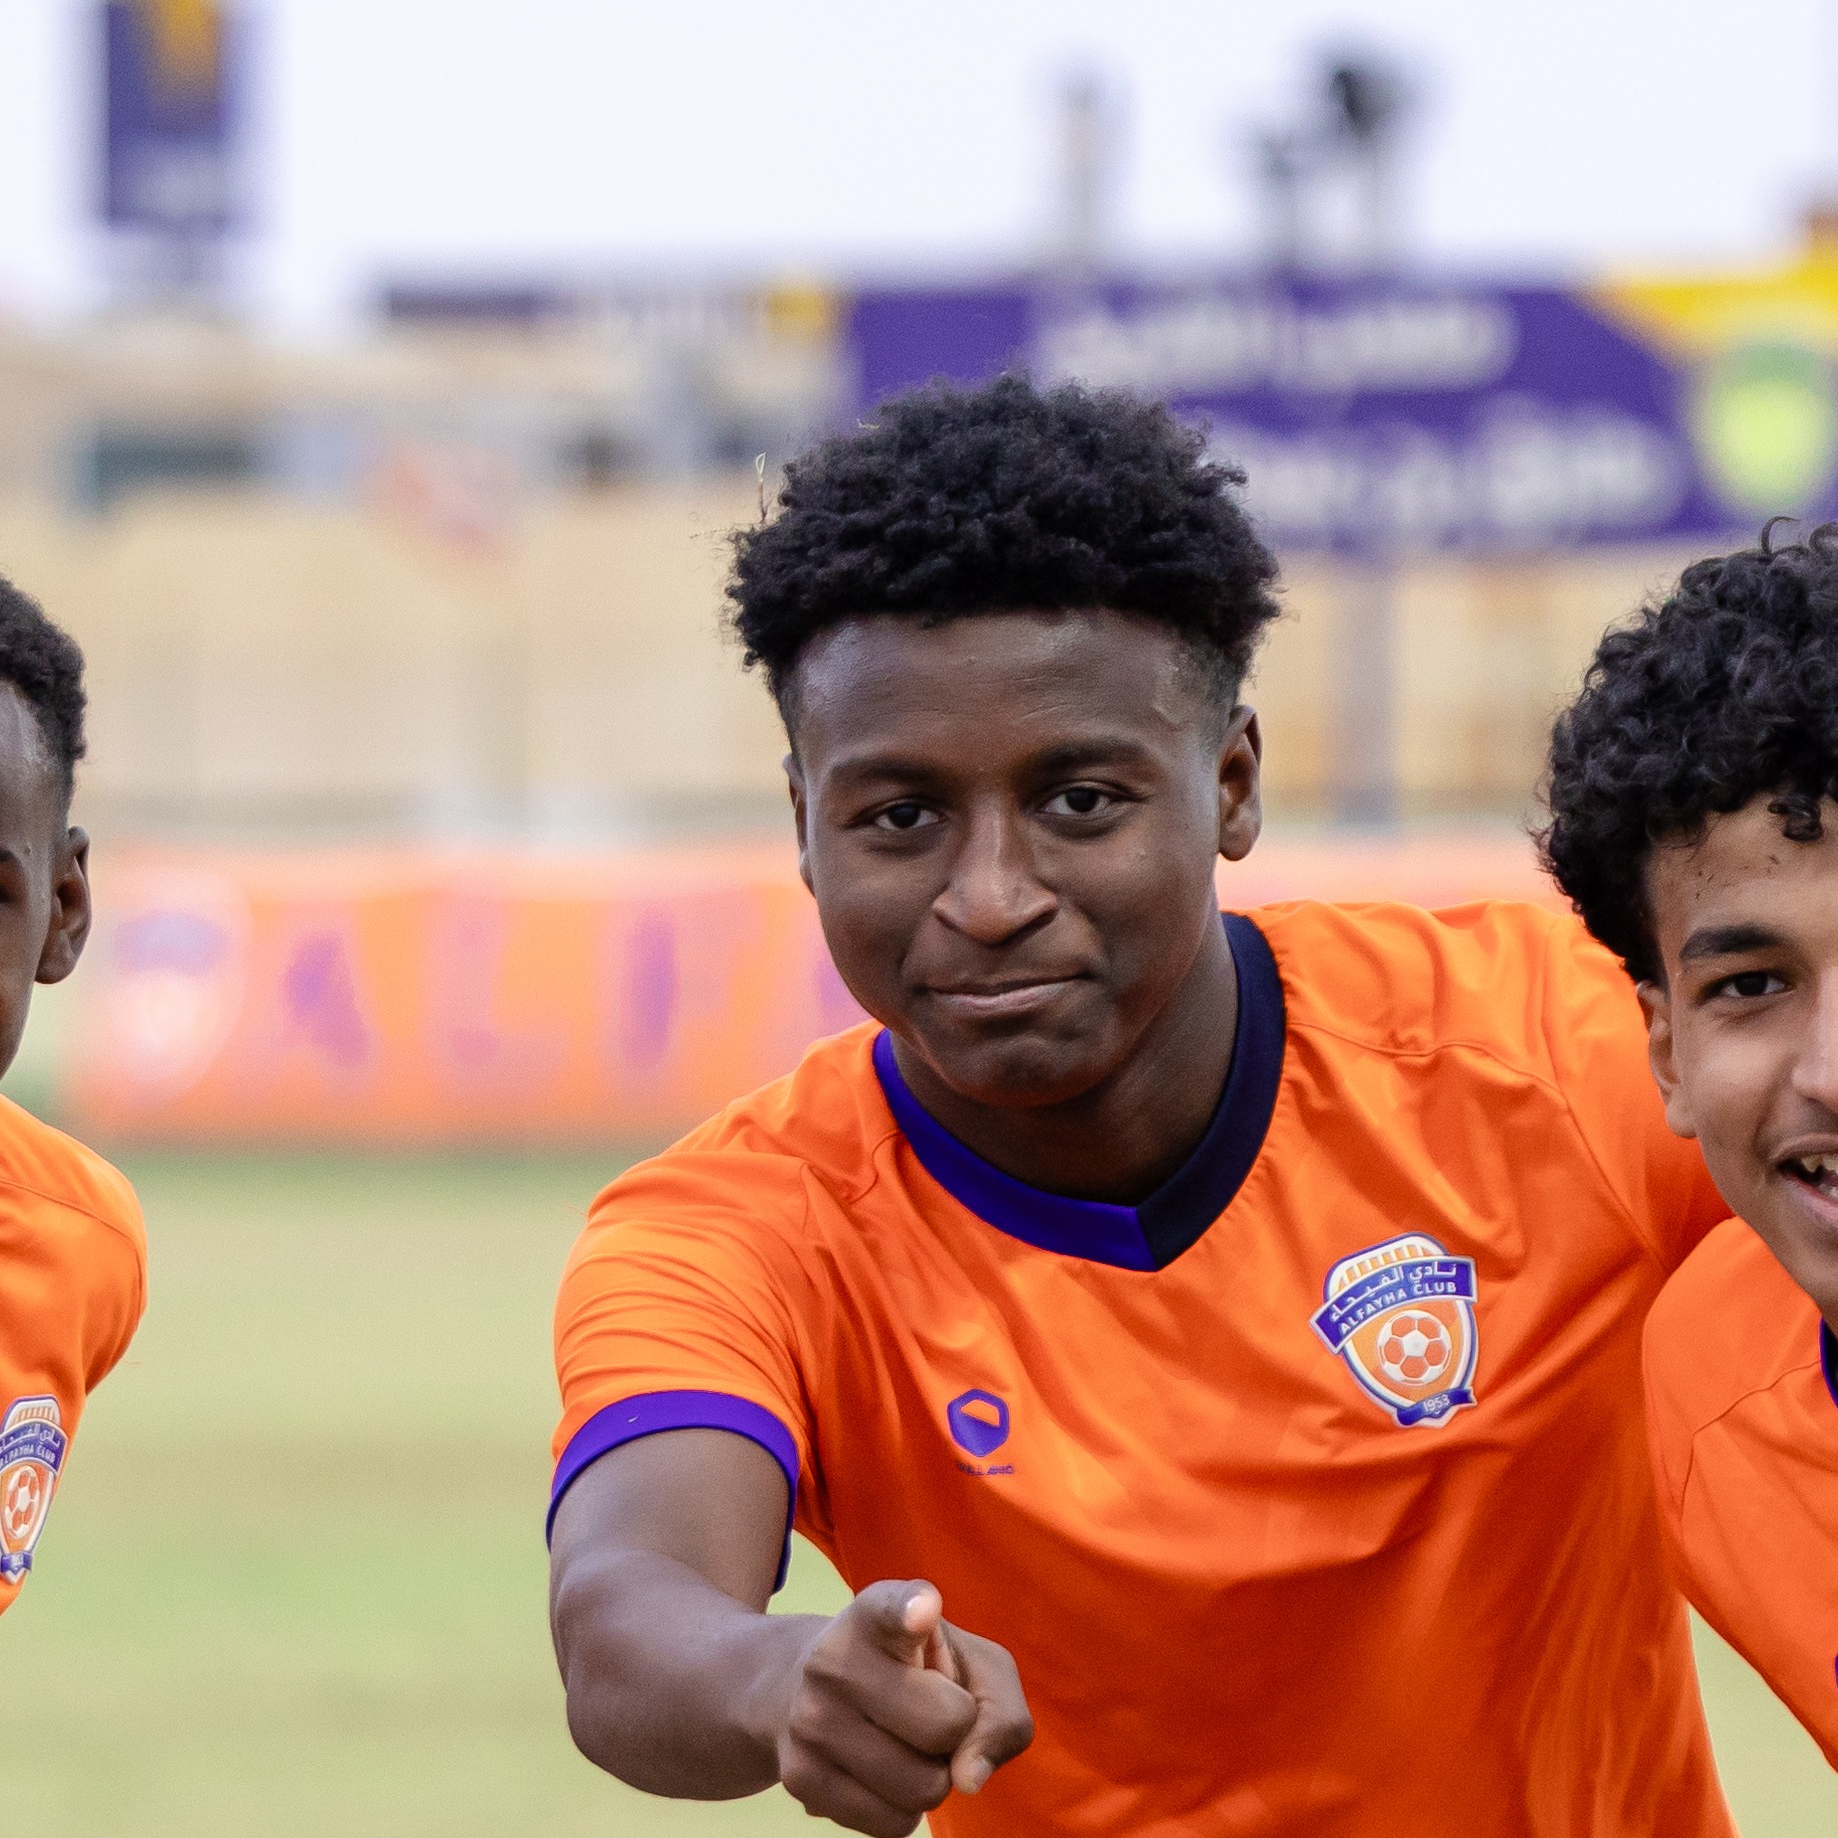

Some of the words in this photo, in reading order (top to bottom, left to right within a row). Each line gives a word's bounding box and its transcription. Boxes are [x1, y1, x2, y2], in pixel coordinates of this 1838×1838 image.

[1409, 1261, 1457, 1284] نادي
[1330, 1266, 1404, 1322] الفيحاء
[1340, 1289, 1407, 1335] ALFAYHA
[1413, 1282, 1457, 1295] CLUB
[1423, 1394, 1450, 1412] 1953
